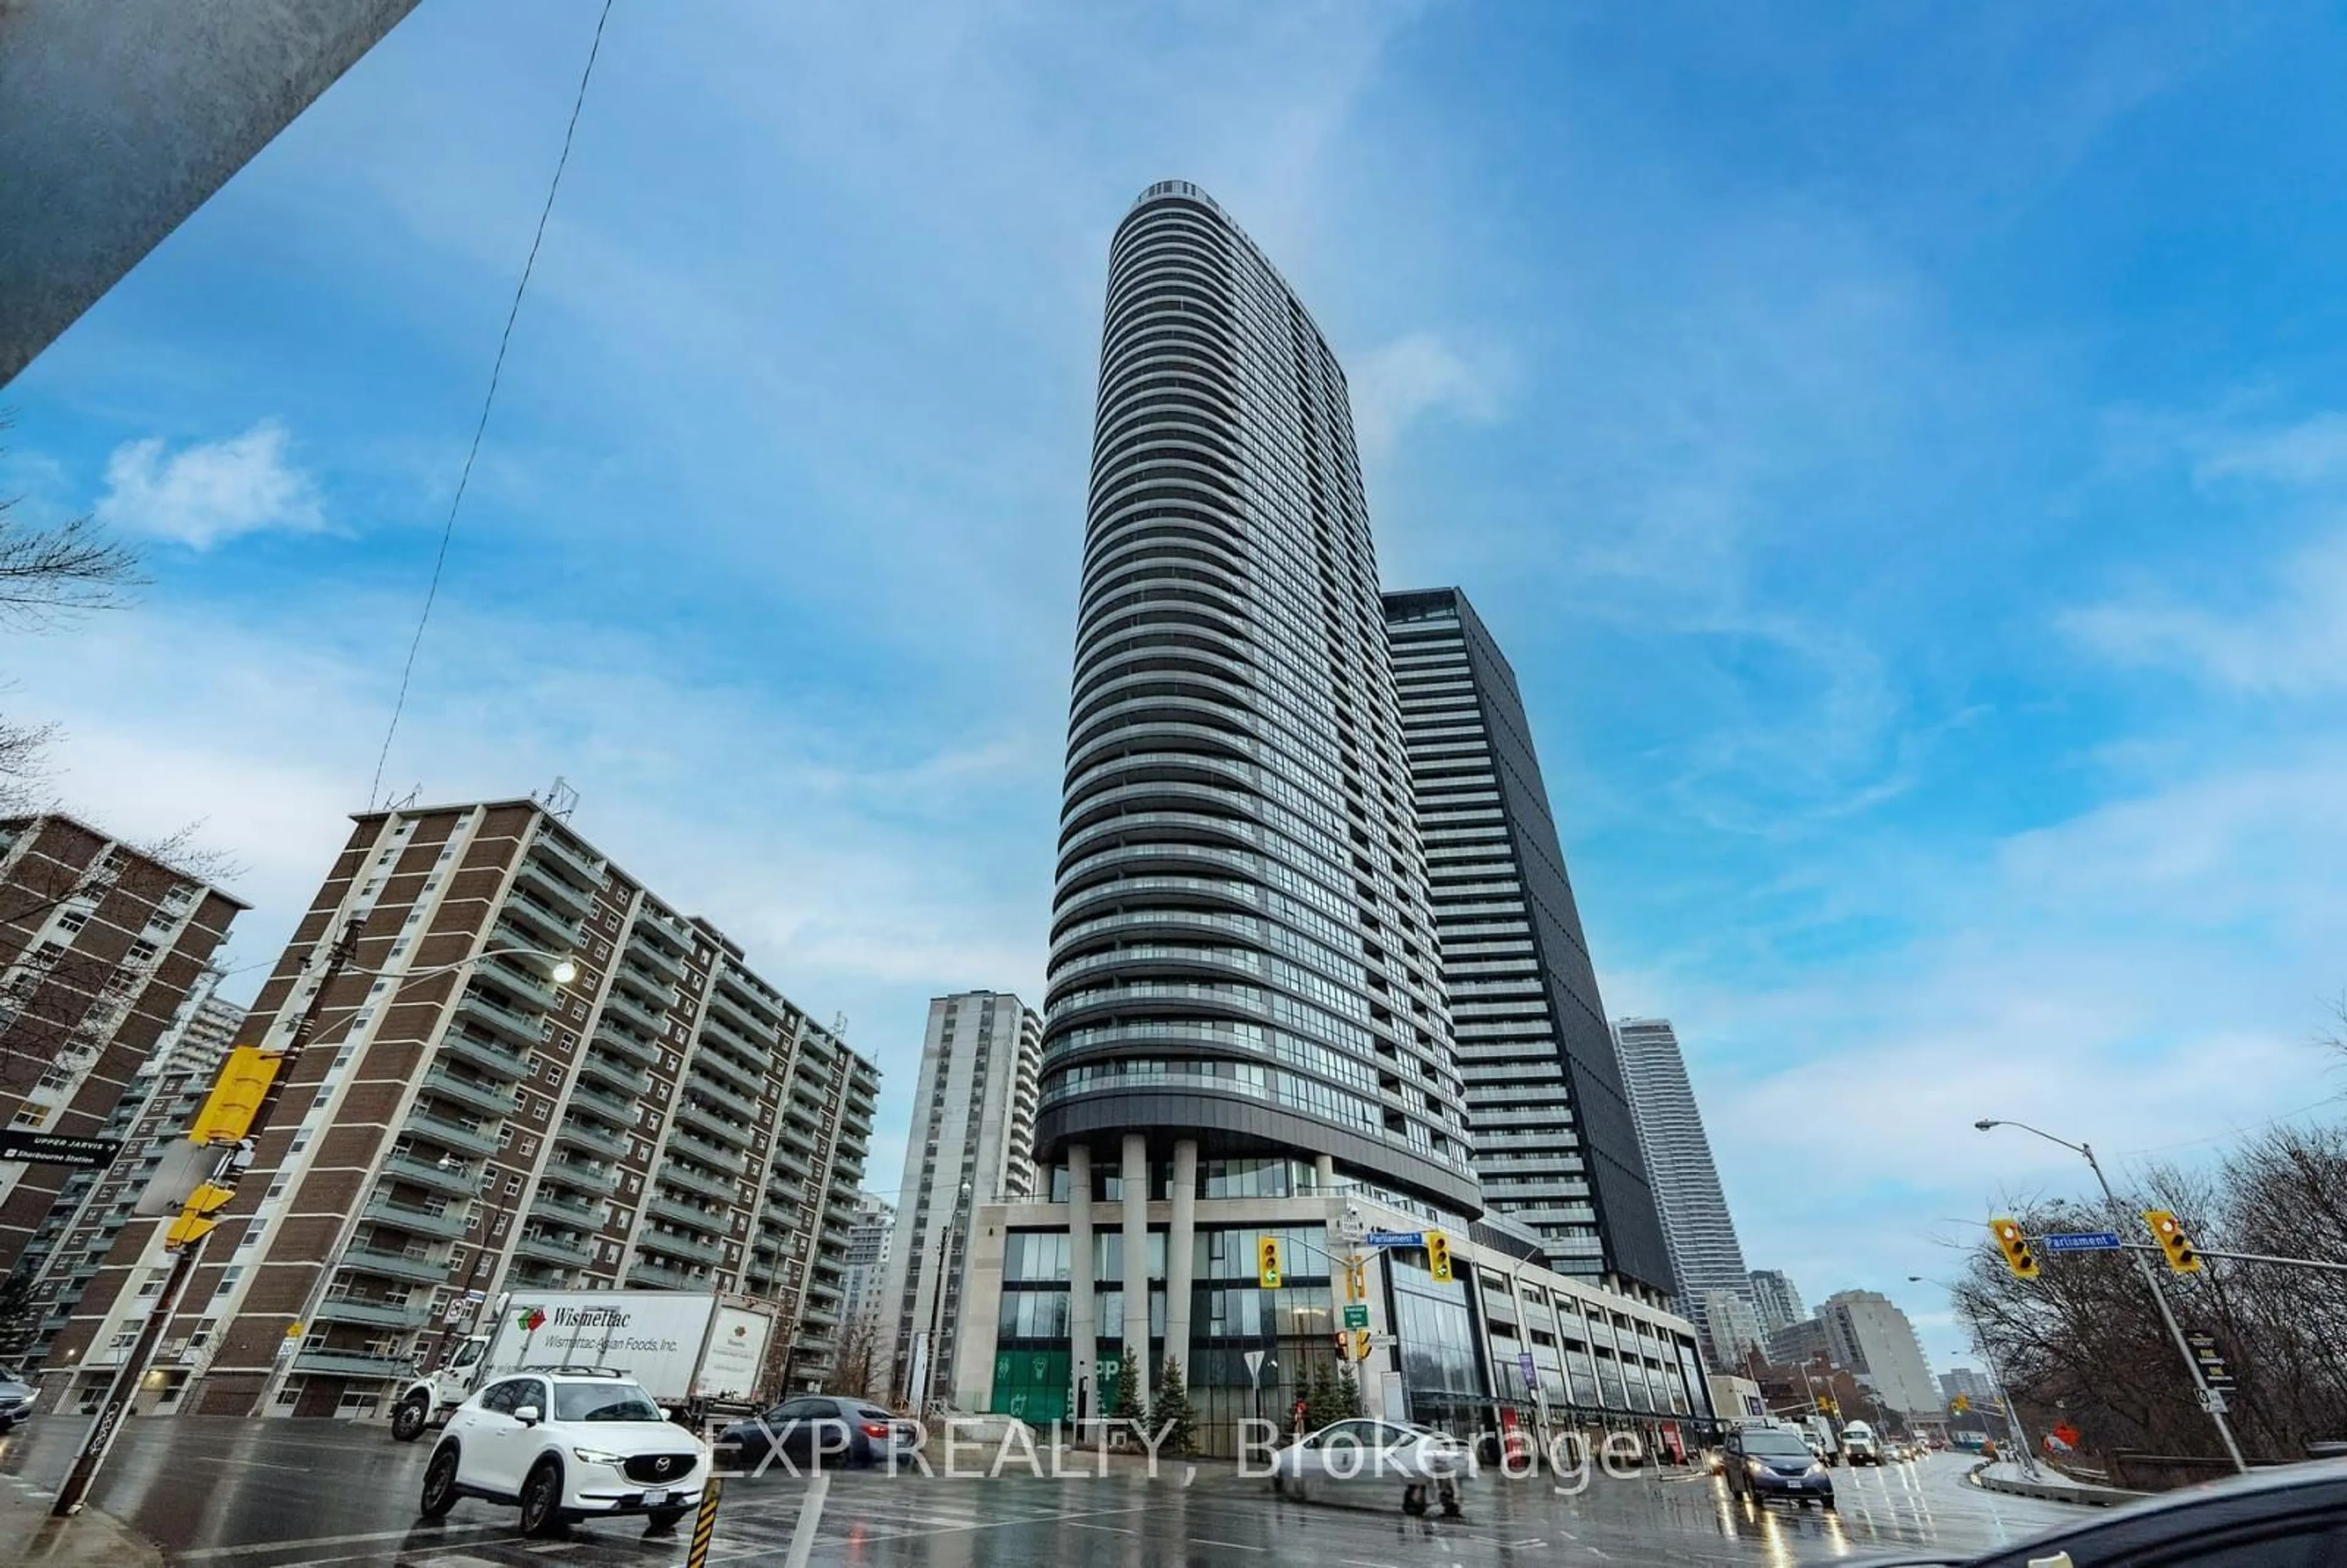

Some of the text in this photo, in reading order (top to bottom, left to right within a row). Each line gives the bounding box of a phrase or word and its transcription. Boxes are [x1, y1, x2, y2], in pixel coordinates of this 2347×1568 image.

[34, 1137, 103, 1150] UPPER JARVIS
[17, 1149, 64, 1162] Sherbourne
[65, 1153, 95, 1164] Station
[1370, 1233, 1413, 1244] Parliament
[2043, 1235, 2109, 1248] Parliament
[554, 1307, 631, 1328] Wismettac
[545, 1335, 677, 1352] Wismettac Asian Foods, Inc.
